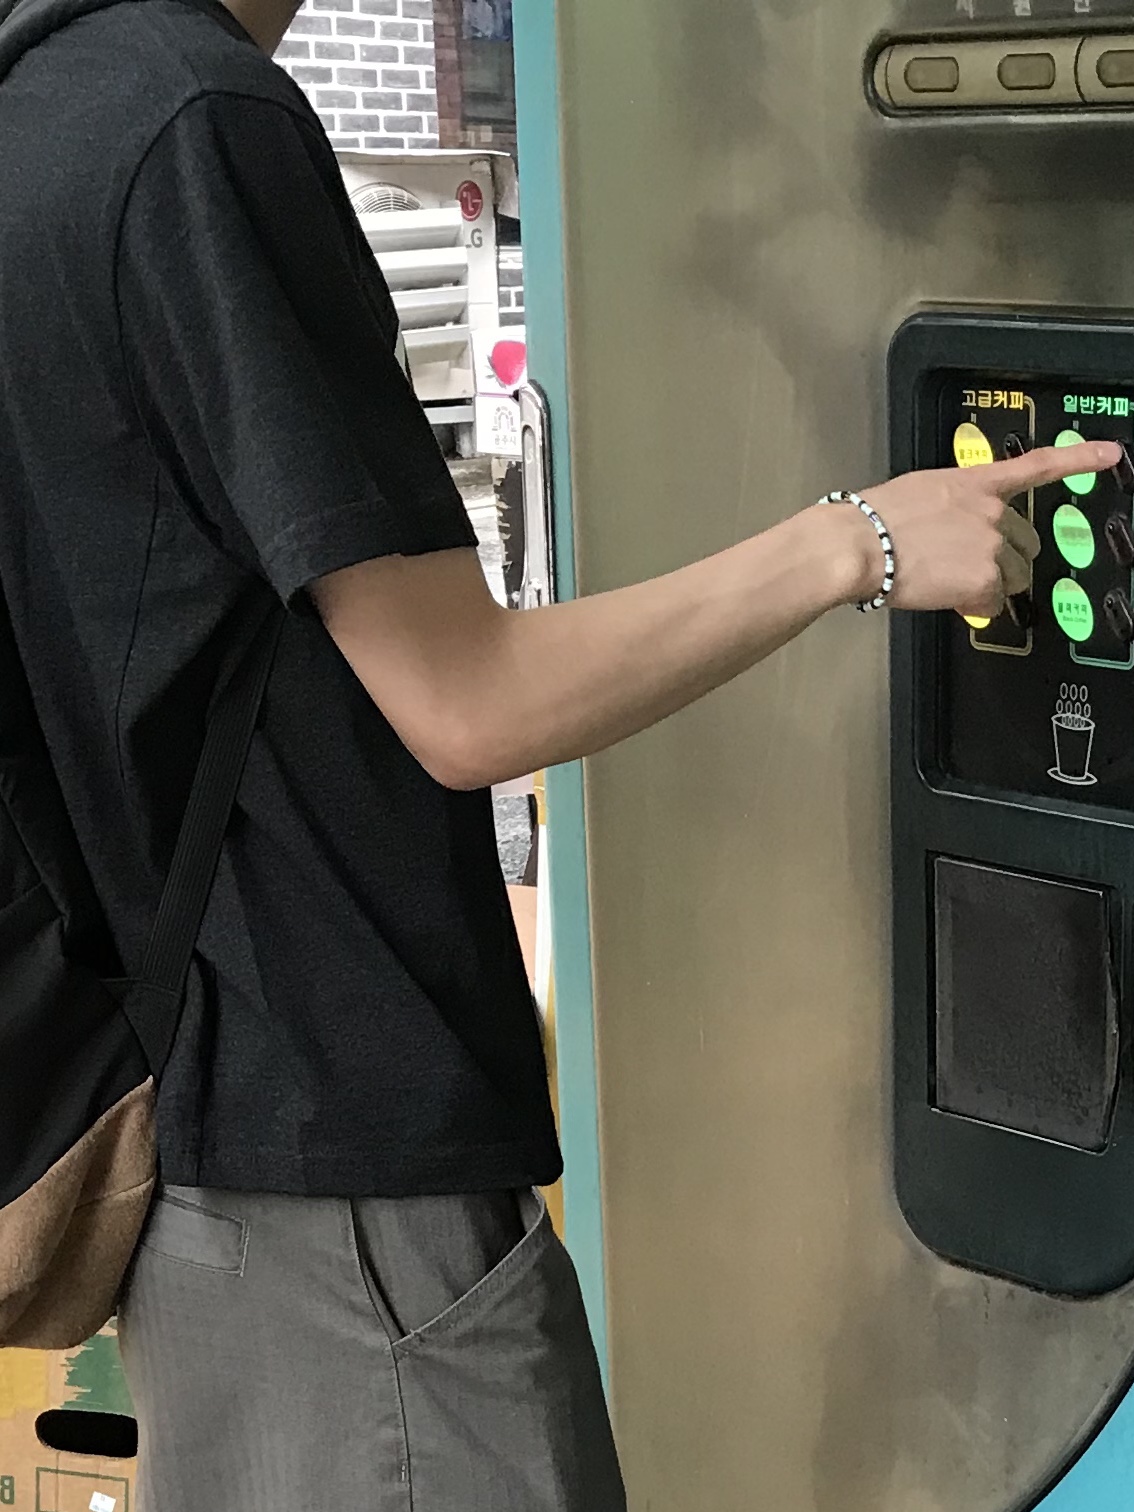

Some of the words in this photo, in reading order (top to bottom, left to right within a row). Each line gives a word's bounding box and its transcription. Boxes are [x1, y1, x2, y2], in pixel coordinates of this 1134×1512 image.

[466, 228, 483, 248] G
[961, 390, 1025, 410] 고급커피
[1063, 395, 1130, 417] 일반커피
